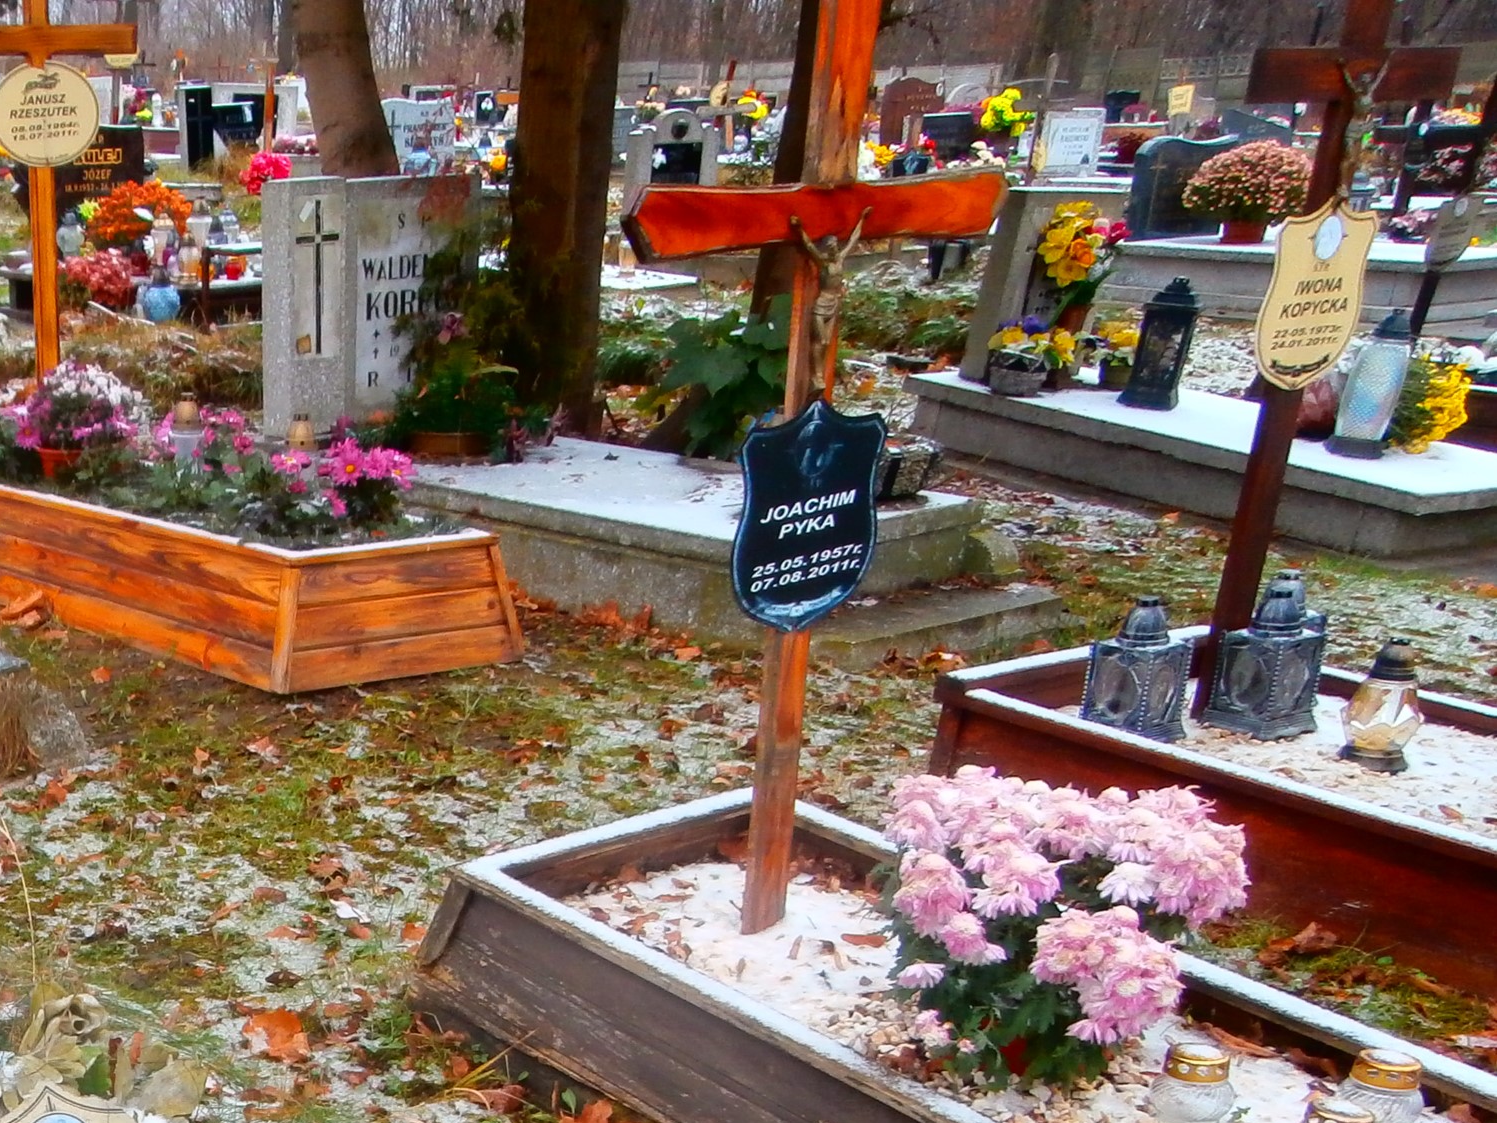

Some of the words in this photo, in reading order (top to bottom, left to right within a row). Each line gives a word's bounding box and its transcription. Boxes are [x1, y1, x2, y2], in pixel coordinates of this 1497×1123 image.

[9, 106, 78, 119] RZESZUTEK
[20, 93, 67, 106] JANUSZ
[362, 253, 430, 282] WALDE
[1293, 276, 1343, 297] IWONA
[1279, 297, 1349, 320] KOPYCKA
[760, 488, 857, 525] JOACHIM
[778, 513, 836, 540] PYKA
[751, 543, 863, 579] 25.05.1957r.
[749, 557, 861, 593] 07.08.2011r.
